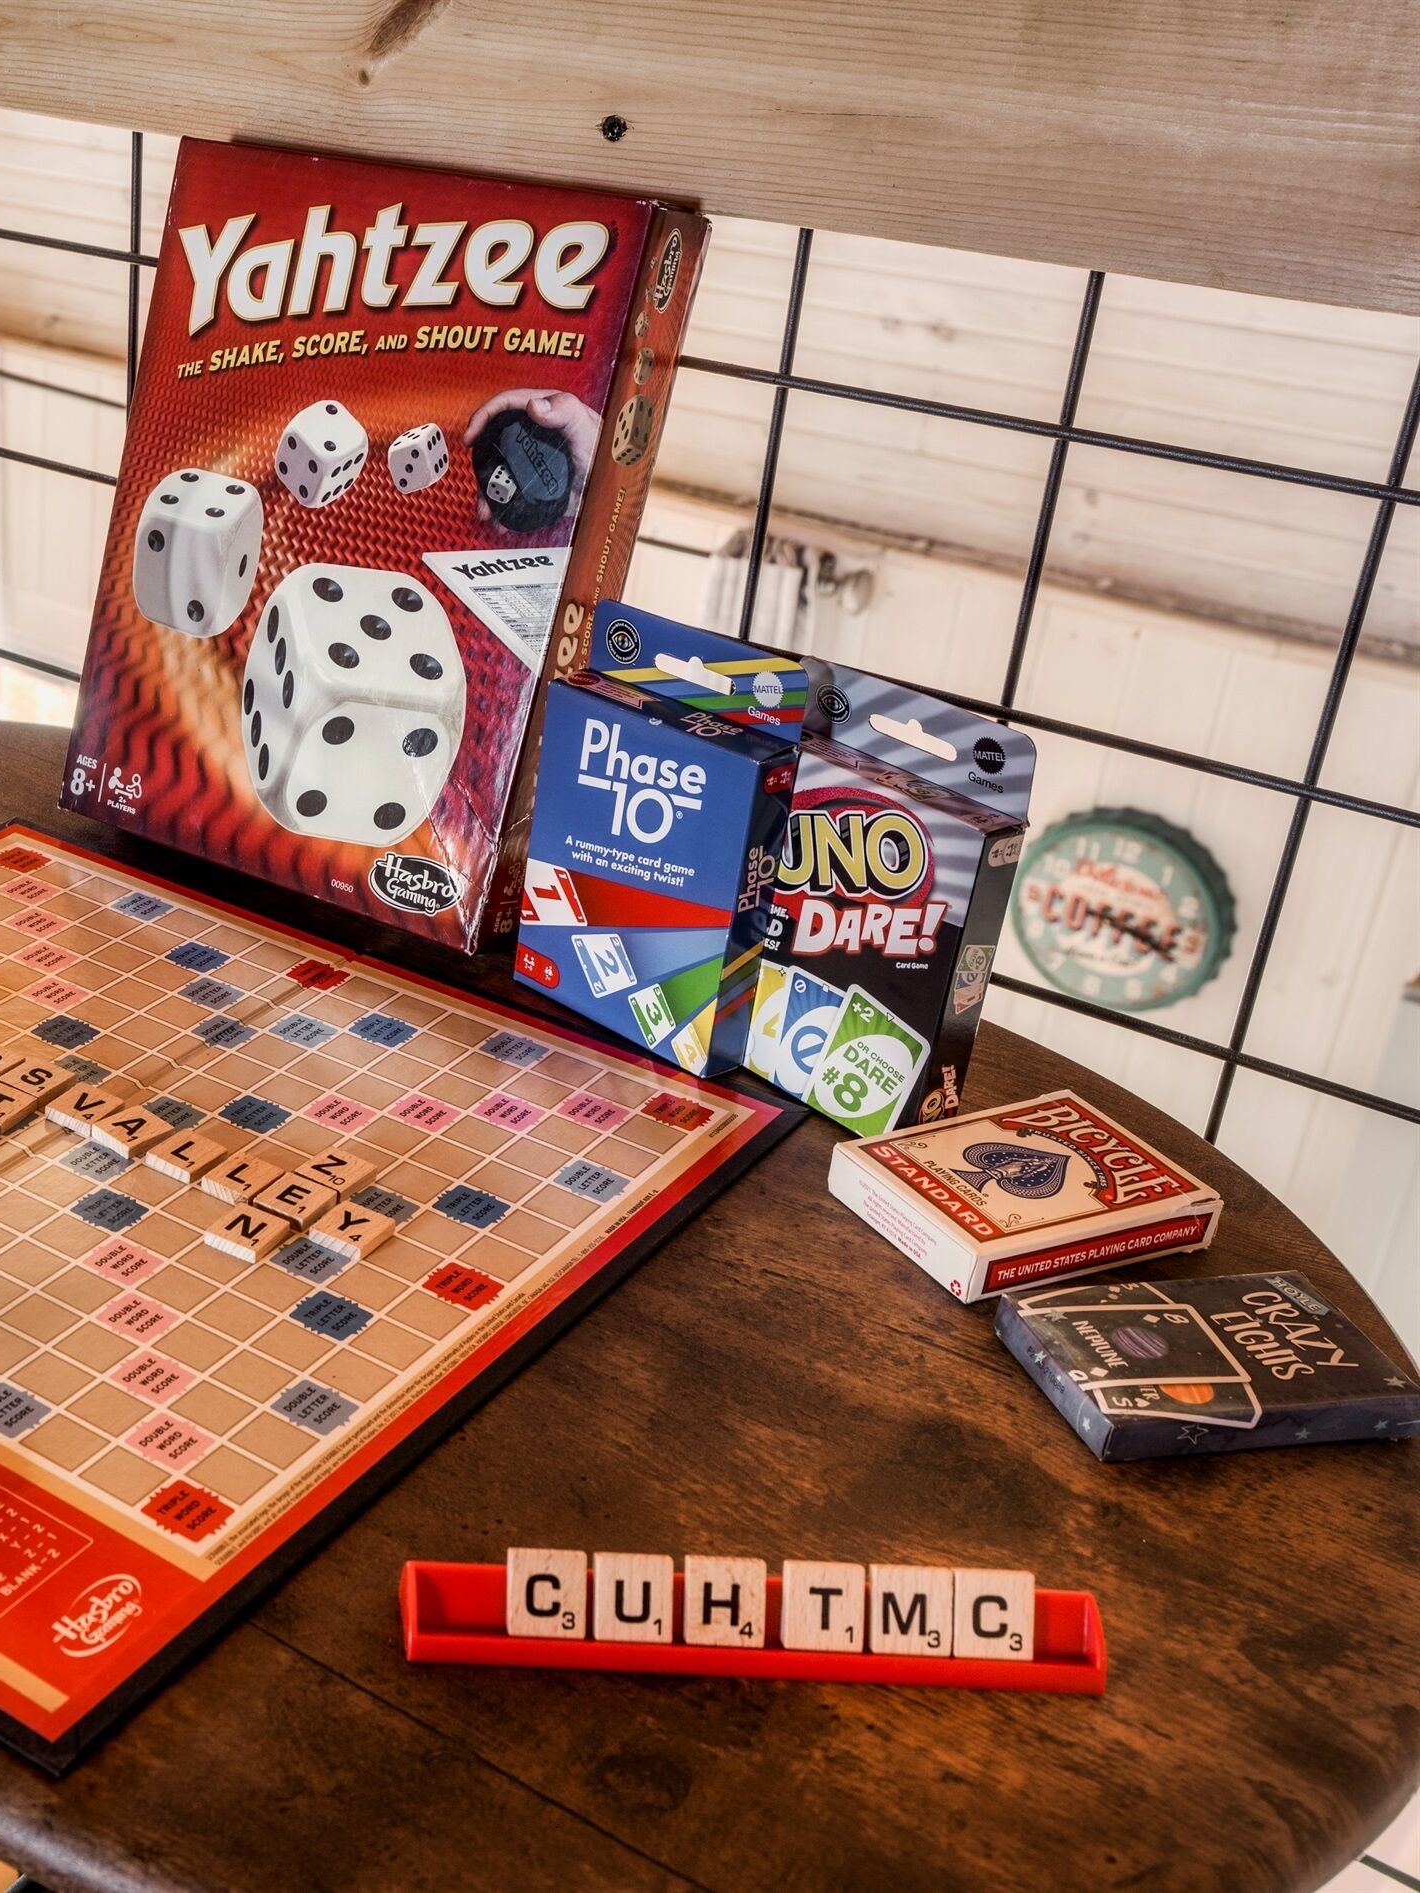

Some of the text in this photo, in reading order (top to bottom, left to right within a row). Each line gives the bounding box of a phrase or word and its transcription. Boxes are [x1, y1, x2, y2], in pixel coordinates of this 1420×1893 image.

[179, 202, 609, 336] Yahtzee
[654, 235, 678, 301] Hasbro
[178, 325, 586, 379] THE SHAKE, SCORE, AND SHOUT GAME!
[596, 537, 613, 582] SHOUT
[609, 487, 626, 533] GAME!
[452, 555, 554, 580] Yahtzee
[753, 684, 782, 694] MATTEL
[684, 711, 743, 734] Phase
[747, 706, 780, 726] Games
[77, 755, 97, 769] AGES
[580, 718, 706, 794] Phase
[973, 750, 1005, 762] MATTEL
[71, 768, 95, 795] 8+
[968, 771, 1003, 794] Games
[107, 800, 136, 814] PLAYERS
[565, 835, 695, 877] A rummy-type card game
[778, 811, 926, 897] UNO
[376, 854, 452, 897] Hasbro
[571, 851, 684, 886] with an exciting twist!
[738, 848, 758, 912] Phase
[331, 879, 353, 893] 00950
[386, 878, 436, 912] Gaming
[16, 913, 42, 926] DOUBLE
[28, 918, 48, 928] WORD
[35, 921, 58, 932] SCORE
[793, 901, 948, 955] DARE!
[646, 1002, 662, 1026] 3
[843, 1045, 898, 1096] DARE
[857, 1041, 905, 1083] OR CHOOSE
[942, 1064, 959, 1109] DARE!
[568, 1098, 593, 1115] DOUBLE
[583, 1105, 603, 1118] WORD
[594, 1109, 616, 1124] SCORE
[653, 1098, 676, 1114] TRIPLE
[668, 1104, 687, 1117] WORD
[679, 1108, 700, 1123] SCORE
[1011, 1102, 1183, 1203] BICYCLE
[1028, 1129, 1077, 1149] TRUSTED
[1077, 1149, 1101, 1170] SINCE
[565, 1166, 592, 1185] DOUBLE
[578, 1172, 604, 1190] LETTER
[592, 1178, 615, 1194] SCORE
[923, 1159, 987, 1207] PLAYING CARDS
[872, 1145, 995, 1237] STANDARD
[94, 1245, 127, 1267] DOUBLE
[110, 1254, 135, 1270] WORD
[997, 1225, 1199, 1281] THE UNITED STATES PLAYING CARD COMPANY
[120, 1258, 148, 1277] SCORE
[1273, 1280, 1320, 1311] HOYLE
[303, 1299, 332, 1320] TRIPLE
[316, 1304, 346, 1326] LETTER
[330, 1312, 357, 1332] SCORE
[1242, 1291, 1359, 1367] CRAZY
[1072, 1320, 1129, 1369] NEPTUNE
[1210, 1311, 1315, 1380] EIGHTS
[123, 1358, 157, 1383] DOUBLE
[140, 1368, 166, 1386] WORD
[150, 1373, 180, 1394] SCORE
[284, 1387, 317, 1413] DOUBLE
[298, 1395, 330, 1419] LETTER
[4, 1406, 35, 1428] SCORE
[313, 1403, 342, 1425] SCORE
[157, 1489, 190, 1516] TRIPLE
[174, 1499, 202, 1521] WORD
[186, 1506, 217, 1530] SCORE
[52, 1580, 134, 1643] Hasbro
[80, 1600, 143, 1645] Gaming
